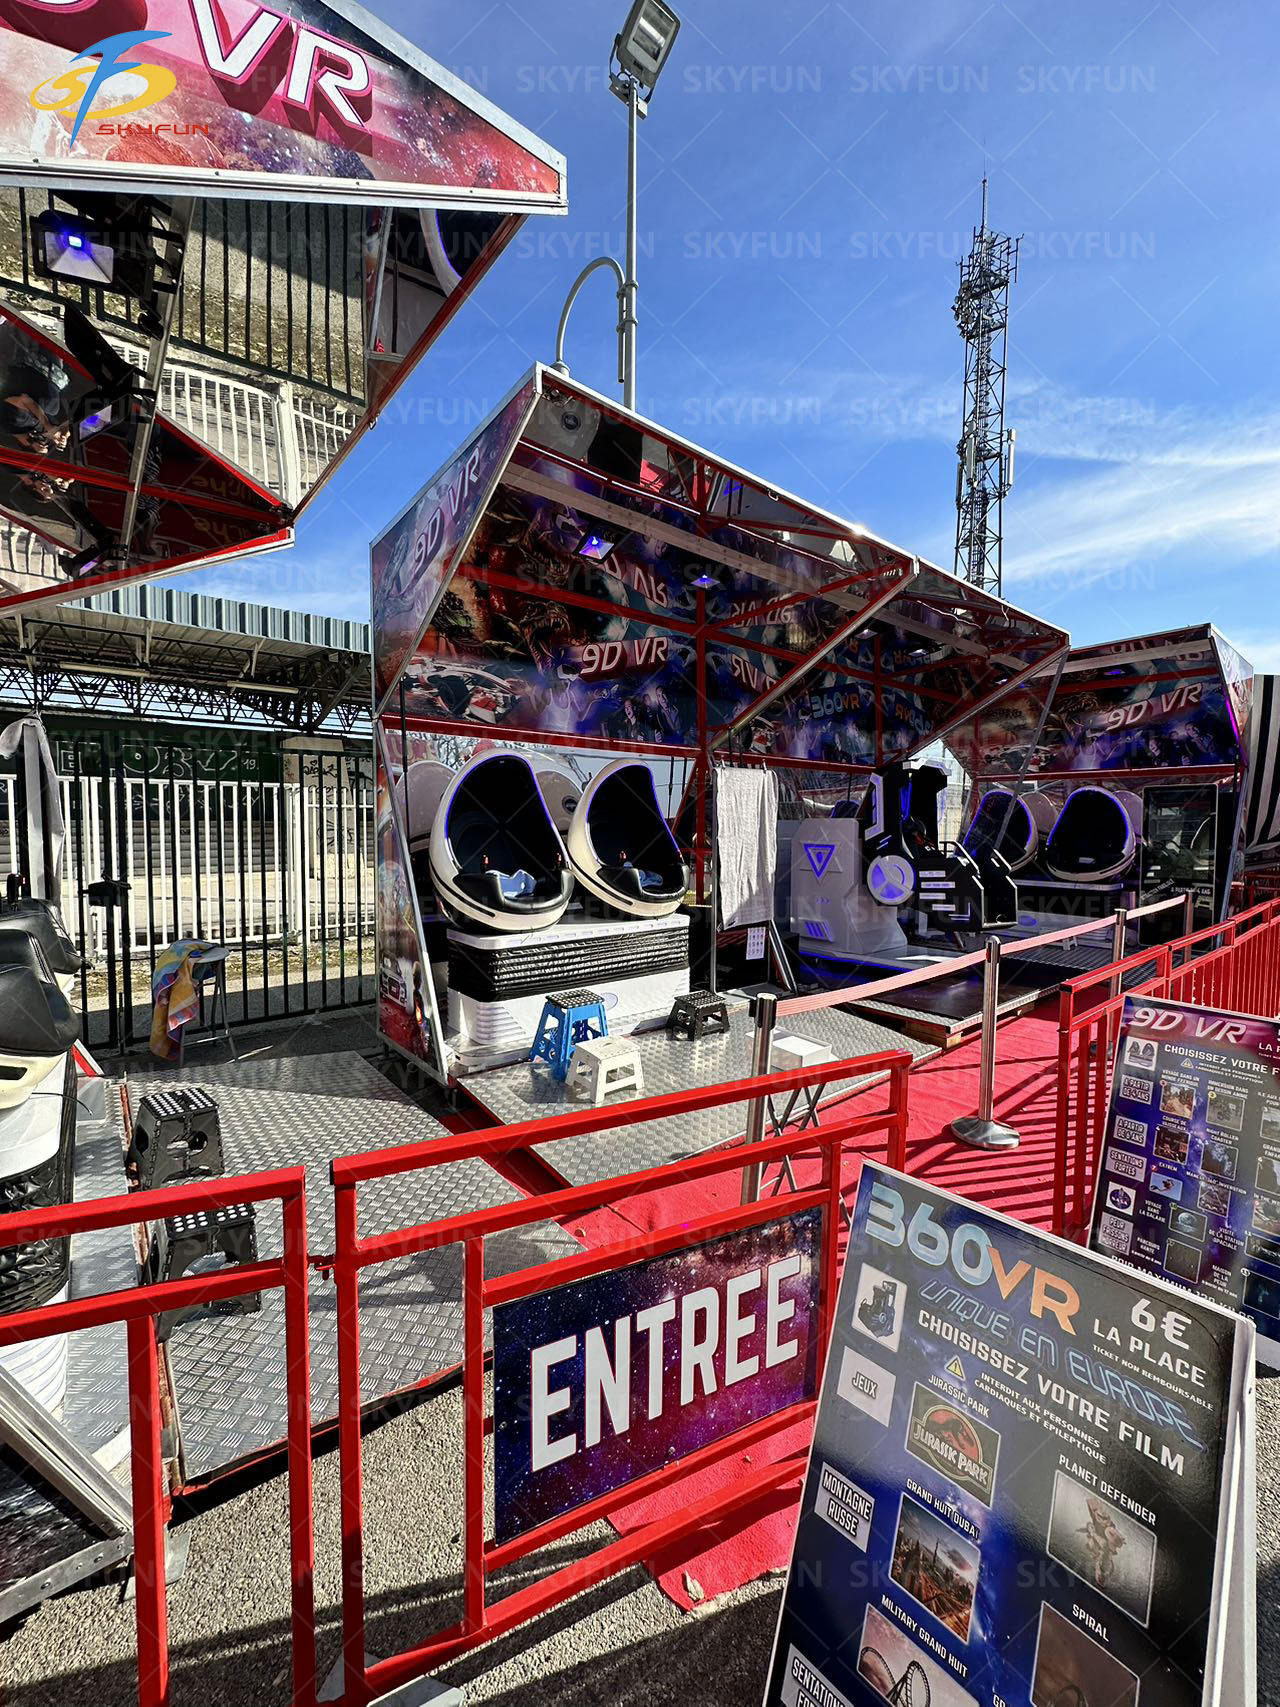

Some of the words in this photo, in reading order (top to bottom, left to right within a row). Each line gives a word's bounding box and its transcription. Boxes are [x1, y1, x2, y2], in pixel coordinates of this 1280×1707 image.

[192, 0, 369, 128] VR
[448, 446, 480, 517] VR
[580, 641, 622, 675] 9D
[634, 636, 668, 665] VR
[1106, 699, 1149, 731] 9D
[1161, 683, 1203, 713] VR
[1128, 1007, 1184, 1031] 9D
[1195, 1016, 1247, 1044] VR
[1164, 1043, 1228, 1065] CHOISISSEZ
[1231, 1058, 1268, 1074] VOTRE
[1114, 1161, 1137, 1177] FORTES
[865, 1182, 1080, 1337] 360VR
[531, 1254, 802, 1473] ENTREE
[850, 1370, 878, 1400] JEUX
[918, 1279, 1011, 1341] UNIQUE
[1068, 1350, 1206, 1452] EUROPE
[1092, 1318, 1122, 1347] LA
[1129, 1335, 1208, 1389] PLACE
[1092, 1343, 1120, 1362] TICKET
[1121, 1358, 1141, 1373] NON
[1141, 1369, 1215, 1412] REMBOURSABLE
[918, 1309, 1030, 1386] CHOISISSEZ
[1037, 1373, 1111, 1433] VOTRE
[1117, 1419, 1186, 1477] FILM
[928, 1373, 967, 1404] JURASSIC
[967, 1396, 991, 1419] PARK
[974, 1379, 1028, 1416] CARDIAQUES
[1029, 1411, 1041, 1424] ET
[1043, 1420, 1107, 1466] EPILEPTIQUE
[981, 1371, 1021, 1400] INTERDIT
[1022, 1396, 1042, 1413] AUX
[1043, 1408, 1101, 1449] PERSONNES
[912, 1421, 959, 1465] JURASSIC
[956, 1453, 990, 1487] PARK
[822, 1470, 872, 1522] MONTAGNE
[827, 1498, 860, 1538] RUSSE
[906, 1478, 932, 1504] GRAND
[933, 1498, 953, 1519] HUIT
[1058, 1453, 1099, 1488] PLANET
[1100, 1480, 1157, 1527] DEFENDER
[881, 1593, 919, 1633] MILITARY
[918, 1626, 948, 1661] GRAND
[947, 1651, 969, 1679] HUIT
[1071, 1602, 1111, 1642] SPIRAL
[792, 1657, 846, 1707] SENTATION
